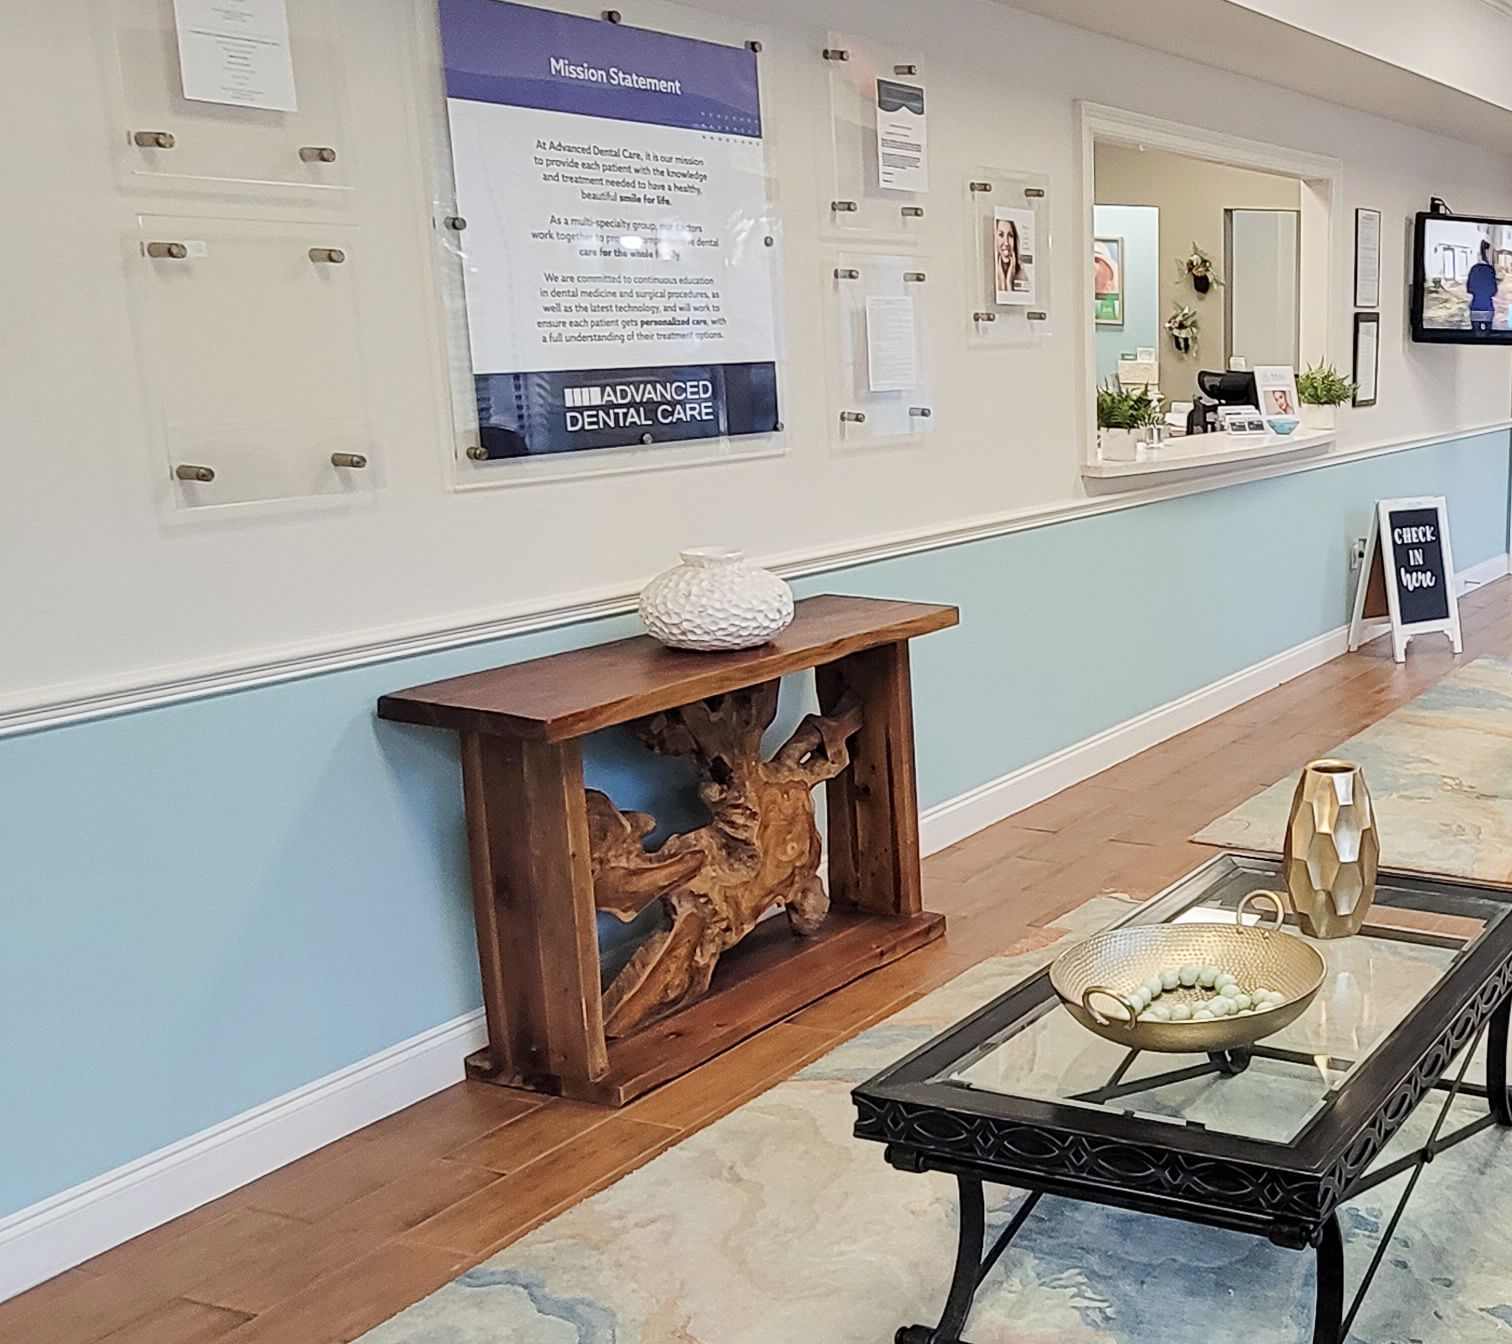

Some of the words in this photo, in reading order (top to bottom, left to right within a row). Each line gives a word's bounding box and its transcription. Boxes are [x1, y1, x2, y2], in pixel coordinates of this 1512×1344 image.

[549, 56, 607, 84] Mission
[608, 67, 682, 95] Statement
[536, 139, 547, 150] At
[548, 140, 592, 155] Advanced
[592, 144, 621, 157] Dental
[621, 148, 644, 162] Care,
[659, 155, 674, 164] our
[674, 155, 705, 166] mission
[533, 156, 544, 166] to
[545, 157, 580, 169] provide
[581, 160, 601, 171] each
[601, 163, 632, 174] patient
[633, 165, 651, 176] with
[652, 167, 666, 177] the
[666, 167, 708, 184] knowledge
[542, 171, 560, 183] and
[561, 173, 605, 187] treatment
[605, 176, 637, 190] needed
[637, 180, 647, 190] to
[647, 180, 666, 192] have
[581, 189, 618, 202] beautiful
[619, 193, 642, 204] smile
[643, 194, 656, 205] for
[549, 214, 562, 226] As
[570, 216, 631, 232] multi-specialty
[531, 229, 555, 240] work
[696, 237, 720, 248] dental
[579, 248, 598, 258] care
[599, 247, 613, 258] for
[613, 247, 628, 258] the
[630, 247, 654, 259] whole
[543, 271, 560, 283] We
[560, 274, 576, 283] are
[576, 272, 622, 285] committed
[622, 275, 633, 284] to
[633, 276, 678, 285] continuous
[678, 276, 715, 285] education
[550, 287, 579, 298] dental
[579, 288, 617, 298] medicine
[618, 288, 634, 298] and
[635, 288, 667, 301] surgical
[667, 289, 711, 301] procedures,
[711, 291, 720, 299] as
[542, 302, 562, 313] well
[563, 304, 574, 313] as
[574, 302, 589, 313] the
[589, 303, 614, 313] latest
[614, 303, 662, 315] technology,
[663, 303, 677, 312] and
[678, 303, 691, 312] will
[692, 303, 711, 313] work
[711, 304, 720, 312] to
[536, 319, 567, 328] ensure
[567, 317, 589, 328] each
[589, 318, 620, 330] patient
[620, 318, 639, 330] gets
[640, 317, 690, 328] personalized
[710, 317, 727, 326] with
[548, 332, 564, 343] full
[564, 332, 626, 344] understanding
[626, 331, 634, 342] of
[635, 331, 655, 342] their
[655, 332, 694, 341] treatment
[602, 380, 713, 405] ADVANCED
[565, 407, 653, 432] DENTAL
[656, 402, 714, 424] CARE
[1393, 525, 1437, 545] CHECK
[1408, 548, 1424, 566] IN
[1400, 567, 1436, 592] here
